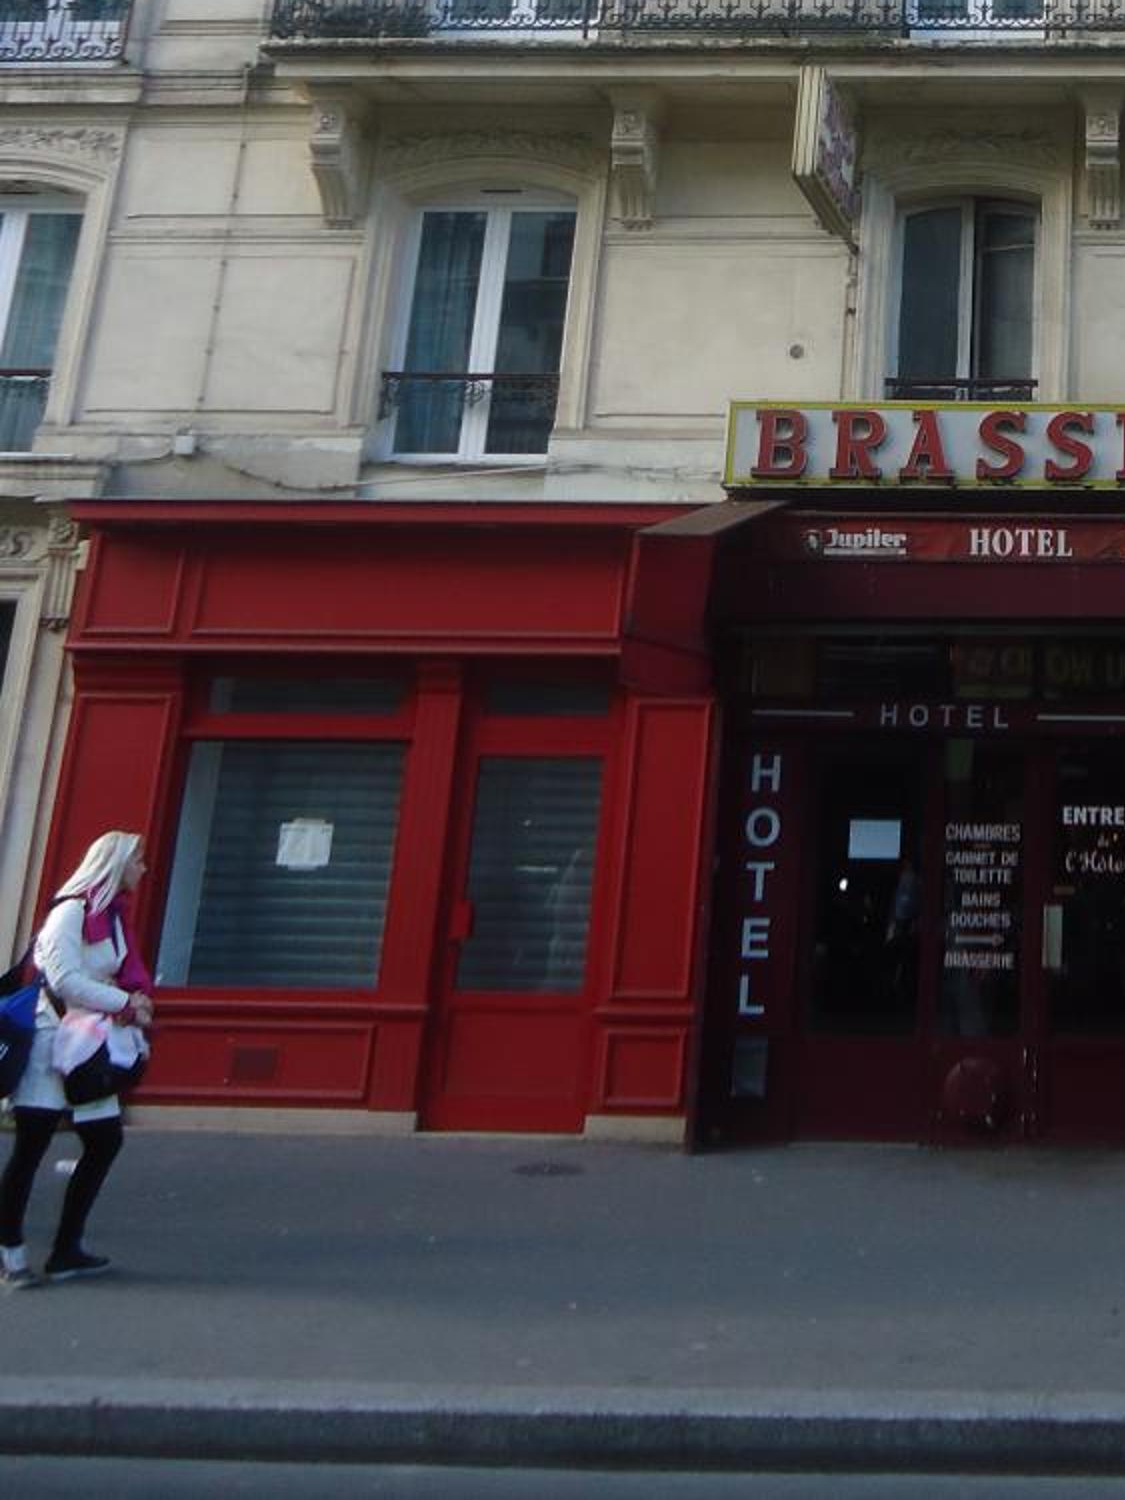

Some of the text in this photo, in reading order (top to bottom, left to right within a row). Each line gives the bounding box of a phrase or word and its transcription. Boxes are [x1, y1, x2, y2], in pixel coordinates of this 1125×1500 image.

[824, 529, 908, 549] Jupiler
[968, 528, 1073, 558] HOTEL
[880, 703, 1010, 729] HOTEL
[945, 822, 1021, 843] CHAMBRES
[945, 851, 1019, 867] CABINET DE
[738, 754, 782, 1016] HOTEL
[954, 867, 1012, 885] TOILETTE
[951, 912, 1012, 929] DOUCHES
[944, 951, 1015, 970] BRASSERIE
